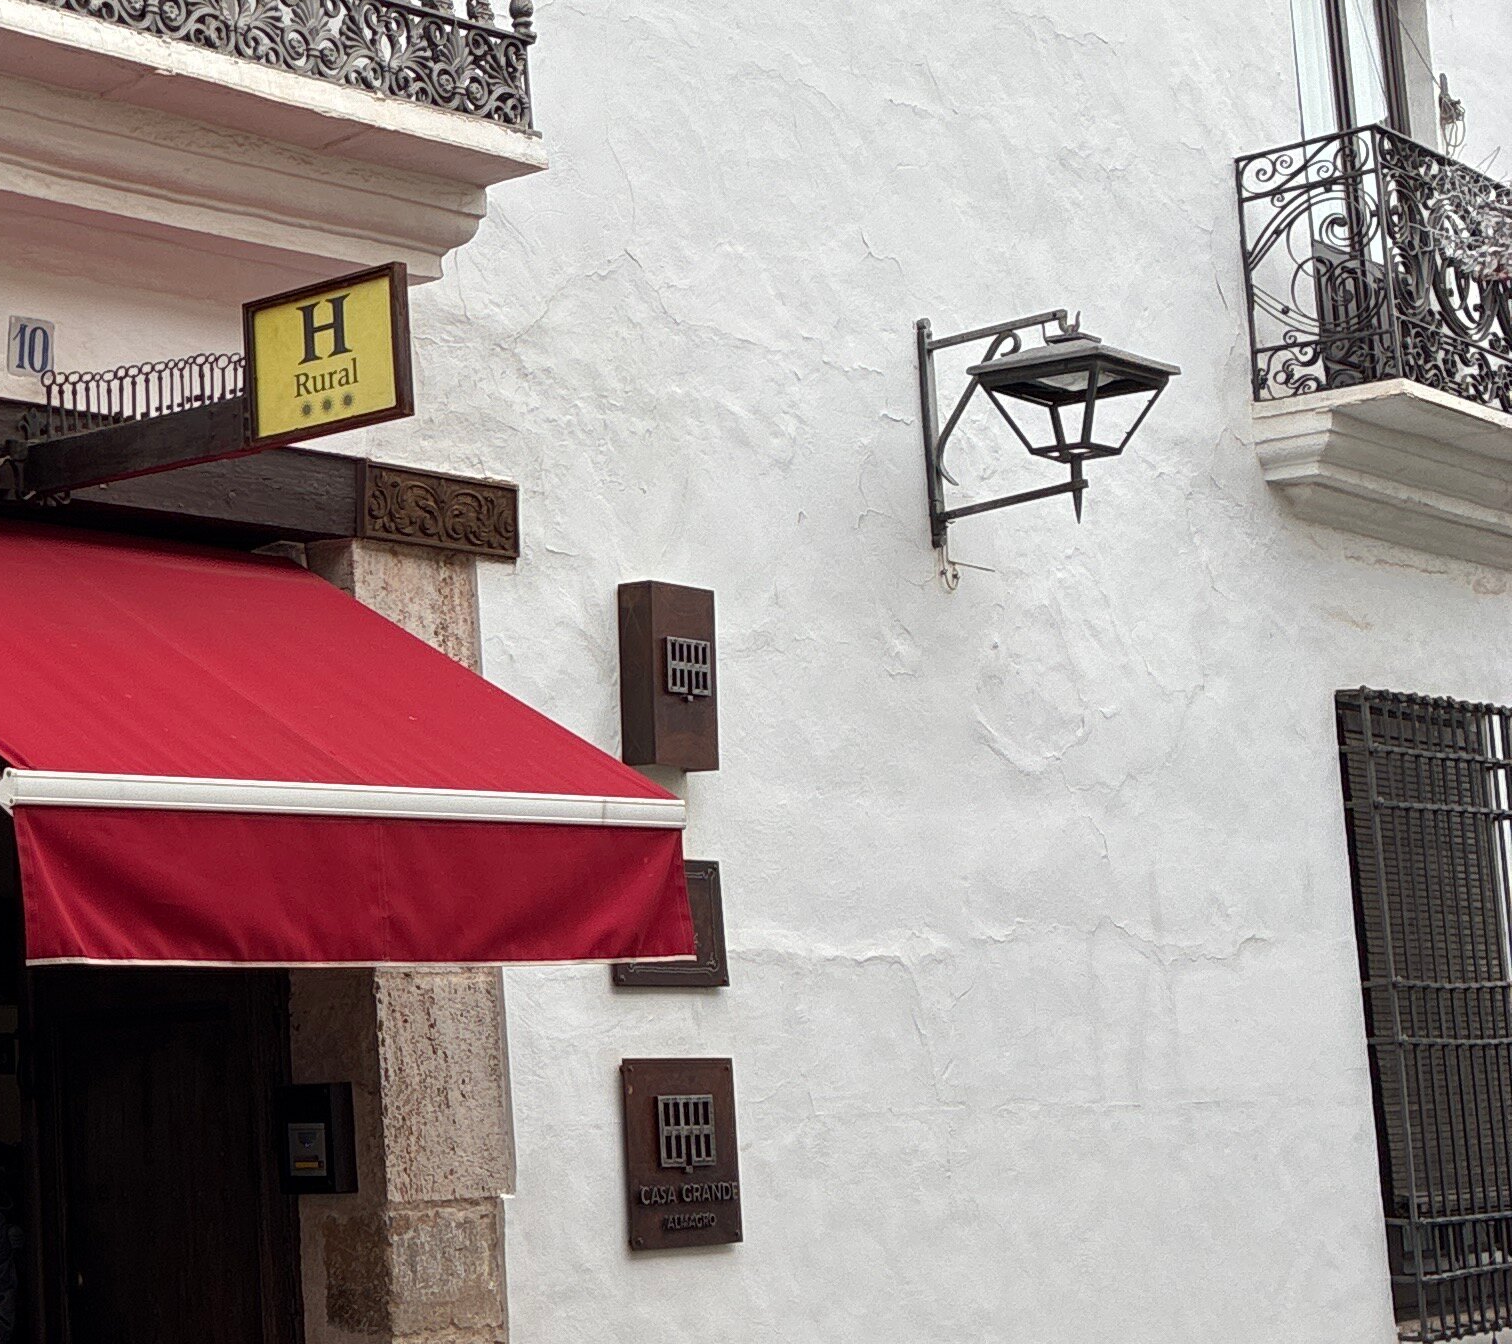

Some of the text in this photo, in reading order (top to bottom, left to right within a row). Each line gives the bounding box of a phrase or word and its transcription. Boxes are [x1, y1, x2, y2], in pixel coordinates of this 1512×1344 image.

[12, 322, 50, 374] 10
[295, 292, 355, 366] H
[293, 358, 361, 399] Rural
[640, 1181, 739, 1206] CASA GRANDE
